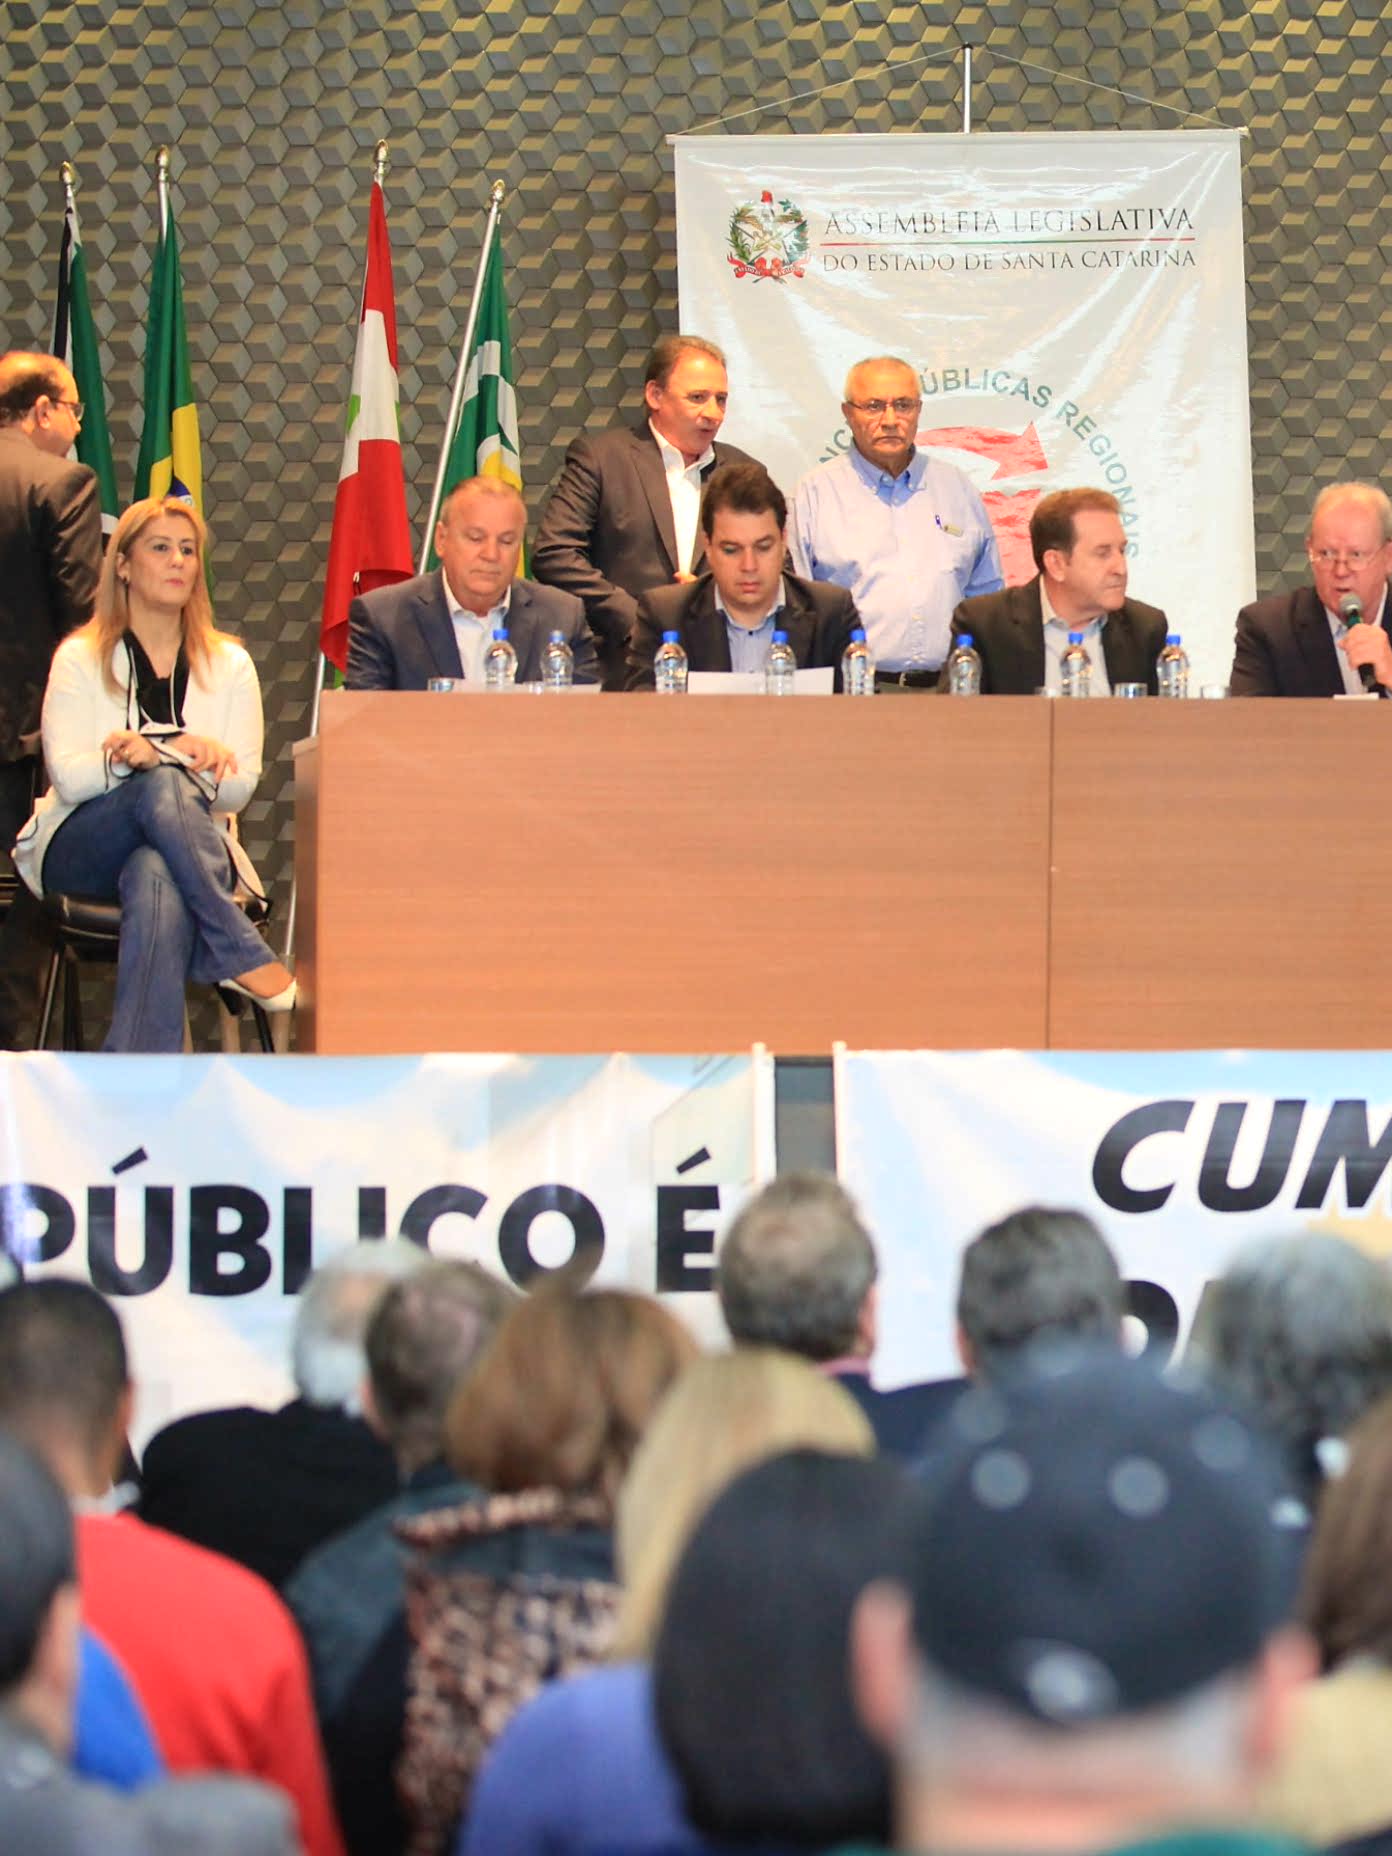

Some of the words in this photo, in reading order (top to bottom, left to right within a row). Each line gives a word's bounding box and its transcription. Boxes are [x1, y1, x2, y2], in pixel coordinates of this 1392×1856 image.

[823, 253, 858, 272] DO
[868, 252, 955, 271] ESTADO
[965, 251, 992, 271] DE
[1001, 250, 1073, 270] SANTA
[1081, 249, 1196, 269] CATARINA
[825, 211, 1001, 235] ASSEMBLEIA
[1013, 207, 1194, 233] LEGISLATIVA
[918, 367, 1053, 408] ÚBLICAS
[1056, 400, 1139, 558] REGIONAIS
[656, 1147, 721, 1293] É
